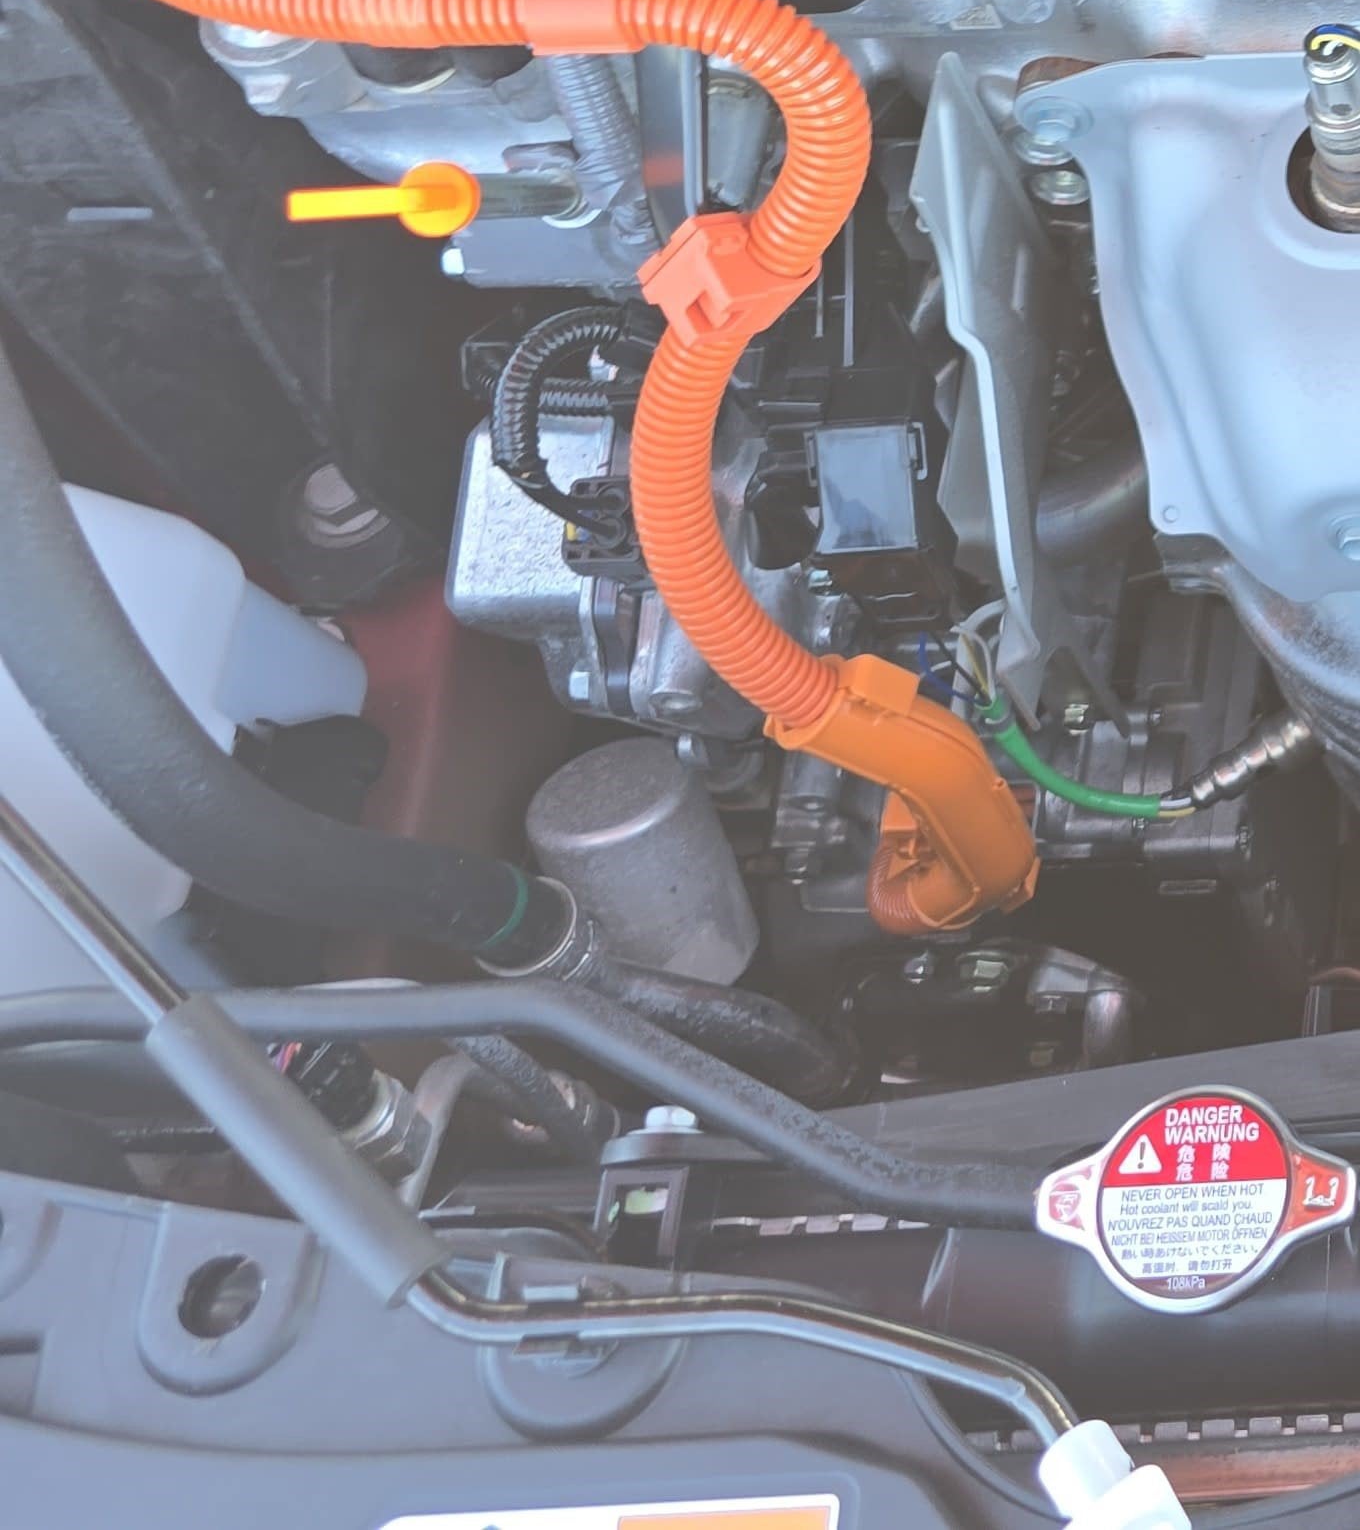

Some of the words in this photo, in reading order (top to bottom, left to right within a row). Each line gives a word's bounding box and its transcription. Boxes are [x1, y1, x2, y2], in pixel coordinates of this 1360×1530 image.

[1166, 1105, 1243, 1127] DANGER
[1165, 1123, 1259, 1146] WARNUNG
[1122, 1187, 1161, 1202] NEVER
[1165, 1186, 1197, 1199] OPEN
[1201, 1185, 1236, 1198] WHEN
[1240, 1184, 1264, 1196] HOT
[1121, 1204, 1138, 1215] Hot
[1142, 1201, 1179, 1214] coolant
[1182, 1200, 1198, 1212] will
[1202, 1199, 1229, 1211] scald
[1108, 1215, 1163, 1231] N'OUVREZ
[1166, 1214, 1188, 1227] PAS
[1192, 1213, 1231, 1227] QUAND
[1234, 1212, 1272, 1224] CHAUD
[1112, 1233, 1138, 1246] NICHT
[1157, 1230, 1195, 1243] HEISSEM
[1199, 1229, 1230, 1242] MOTOR
[1232, 1226, 1267, 1241] ÖFFNEN
[1167, 1276, 1205, 1289] 108kPa
